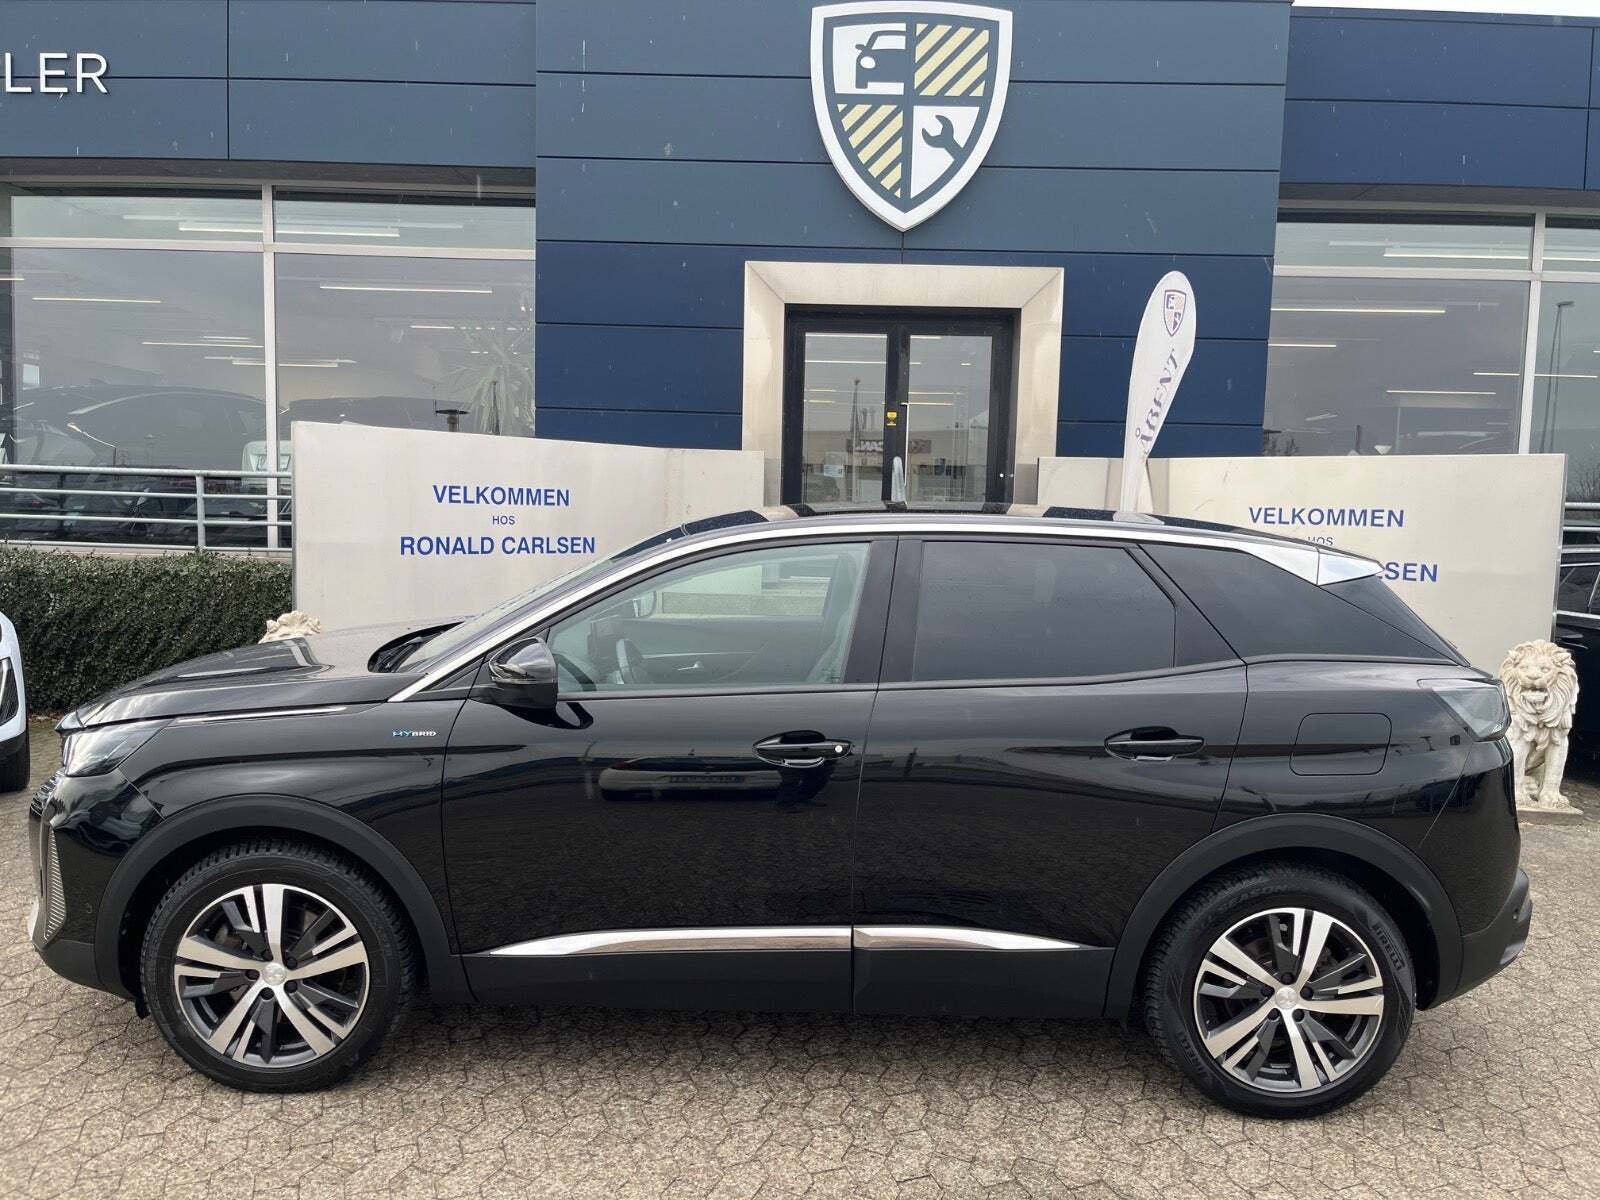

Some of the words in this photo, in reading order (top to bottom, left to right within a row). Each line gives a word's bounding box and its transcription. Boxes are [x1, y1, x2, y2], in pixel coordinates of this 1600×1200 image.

[5, 52, 108, 93] LER
[433, 484, 570, 506] VELKOMMEN
[492, 515, 515, 525] HOS
[1249, 507, 1405, 527] VELKOMMEN
[400, 536, 495, 555] RONALD
[501, 536, 595, 554] CARLSEN
[1376, 562, 1438, 582] SEN
[1371, 923, 1405, 971] PIRELLI
